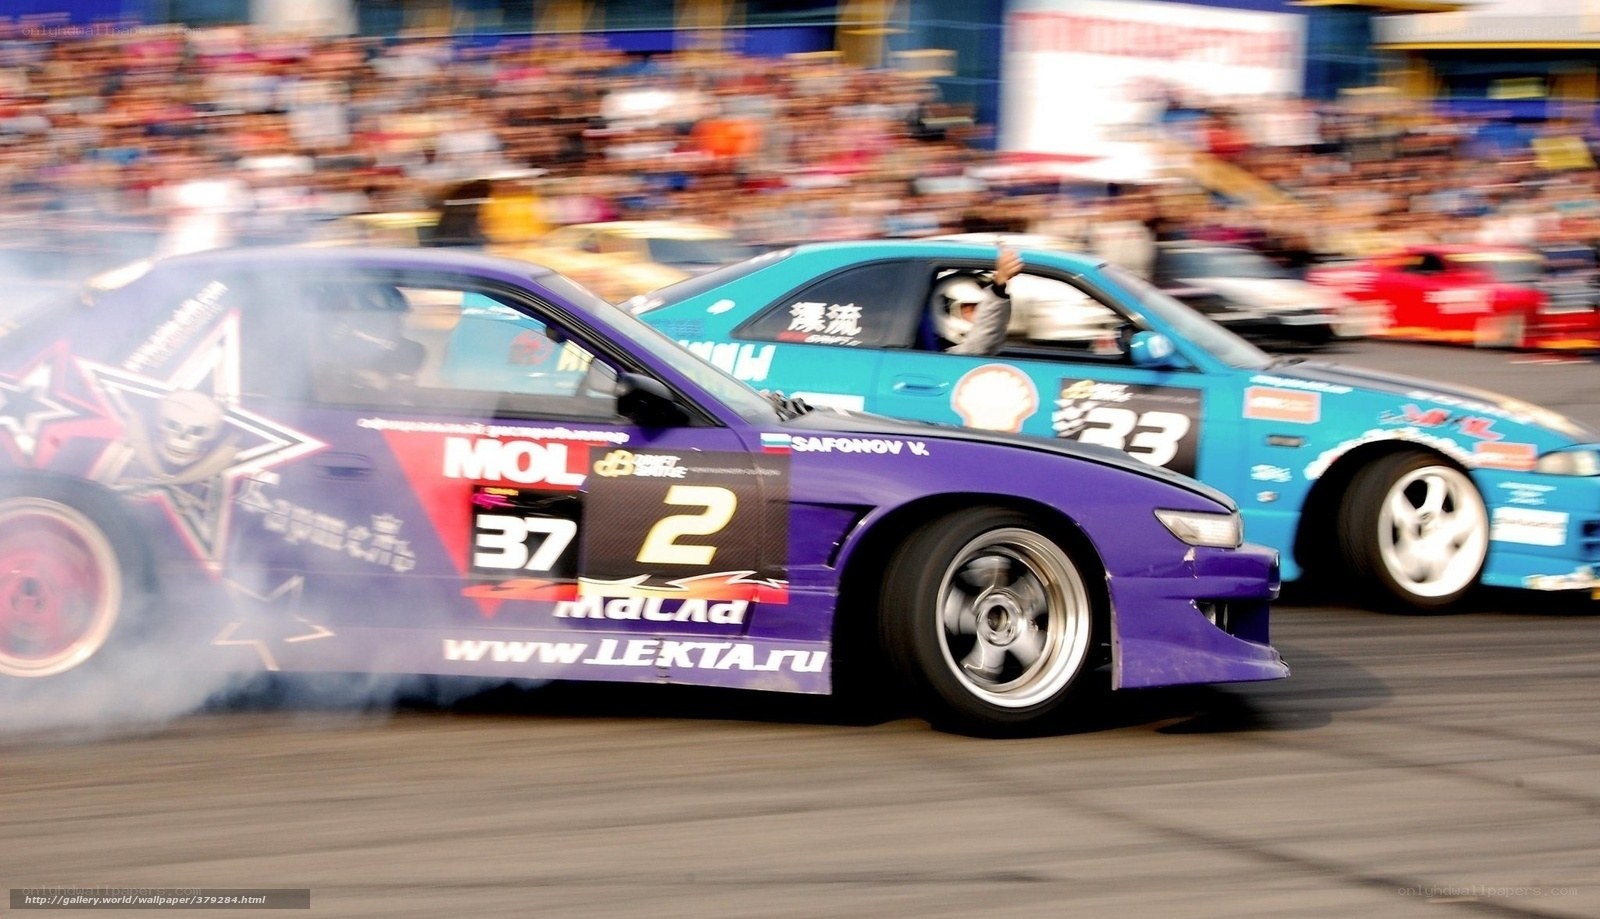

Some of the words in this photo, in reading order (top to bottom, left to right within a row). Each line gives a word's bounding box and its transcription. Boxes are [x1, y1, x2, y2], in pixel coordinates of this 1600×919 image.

[443, 437, 587, 486] MOL
[791, 436, 902, 455] SAFONOV
[908, 441, 930, 456] V.
[473, 514, 578, 571] 37
[636, 484, 738, 565] 2
[443, 638, 829, 673] www.LEKTA.ru
